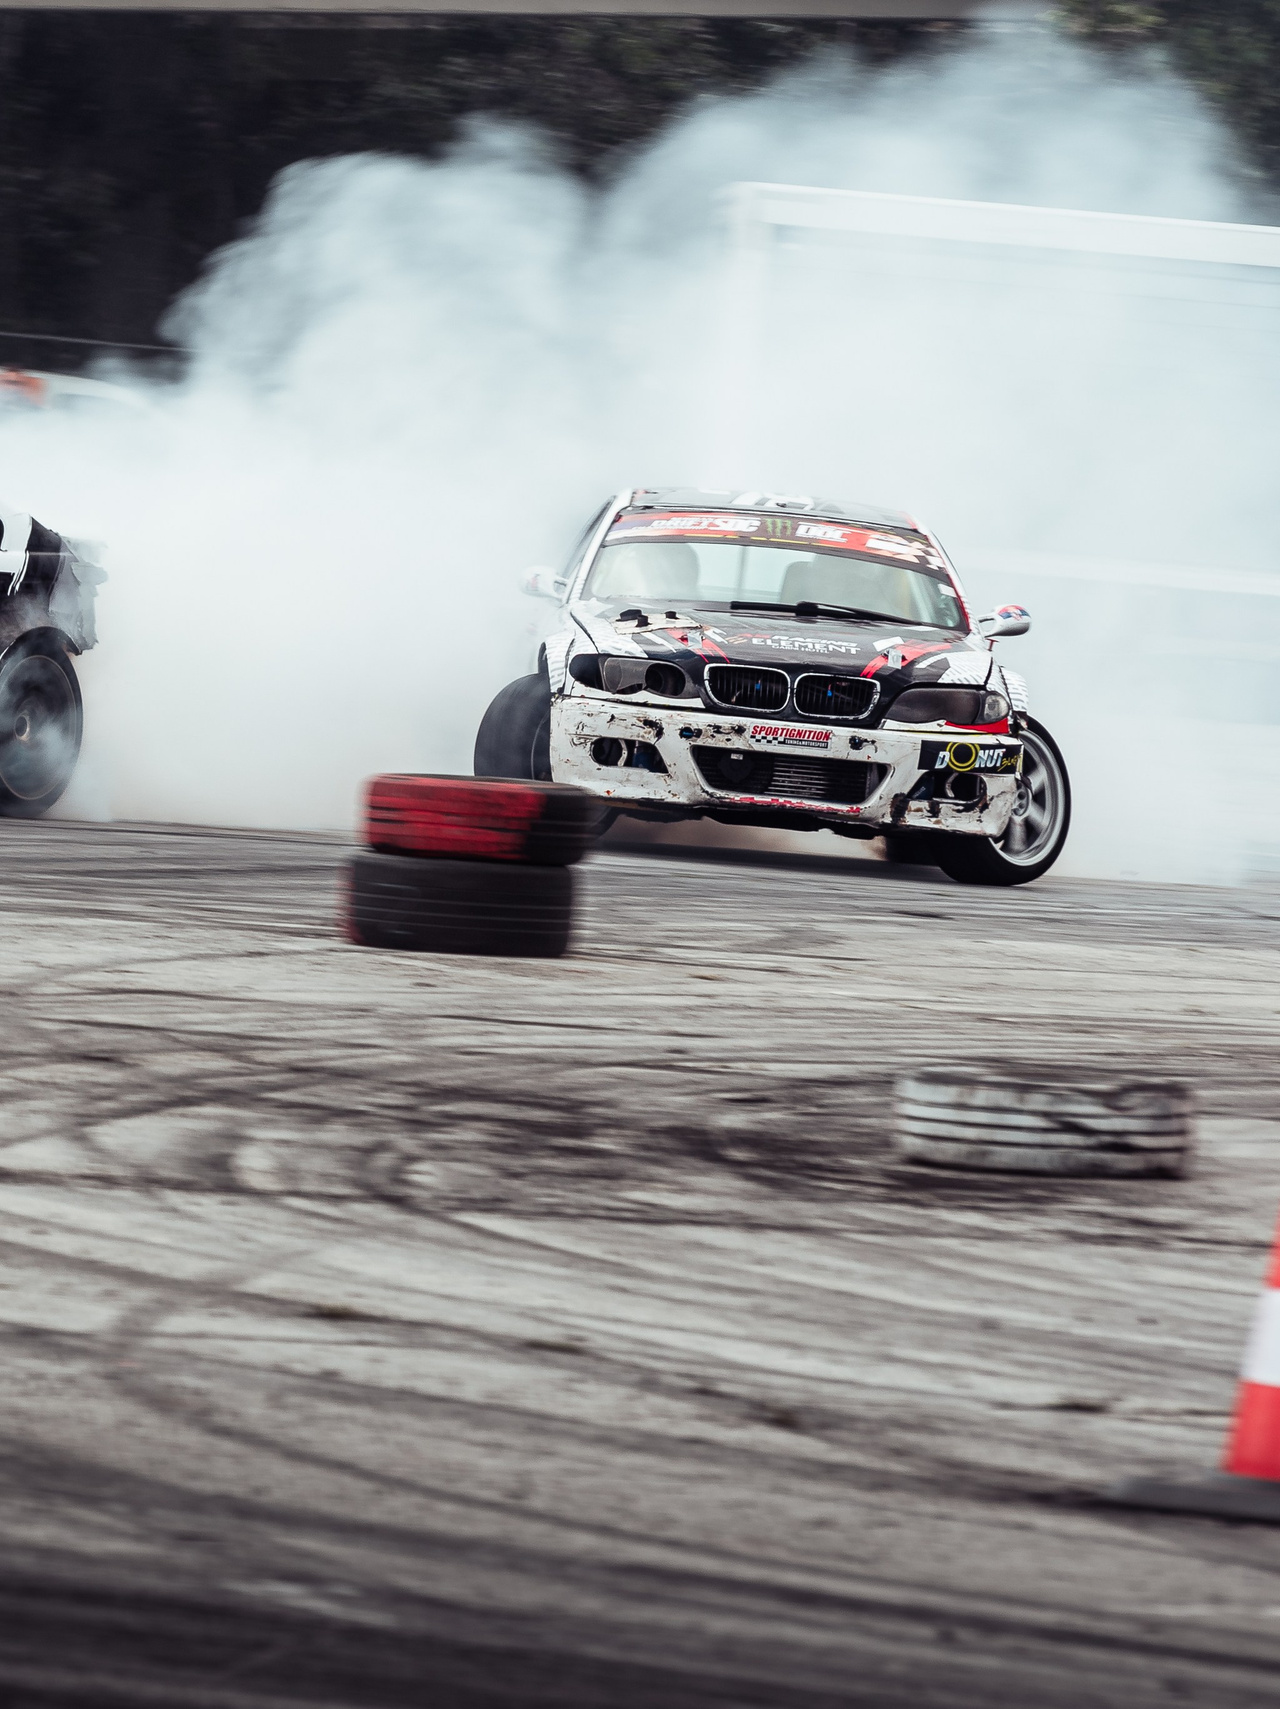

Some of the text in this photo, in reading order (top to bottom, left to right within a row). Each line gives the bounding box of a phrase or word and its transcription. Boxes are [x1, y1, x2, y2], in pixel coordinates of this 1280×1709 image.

[752, 638, 861, 655] ELEMENT
[751, 725, 831, 741] SPORTIGNITION
[934, 741, 1006, 772] DONUT
